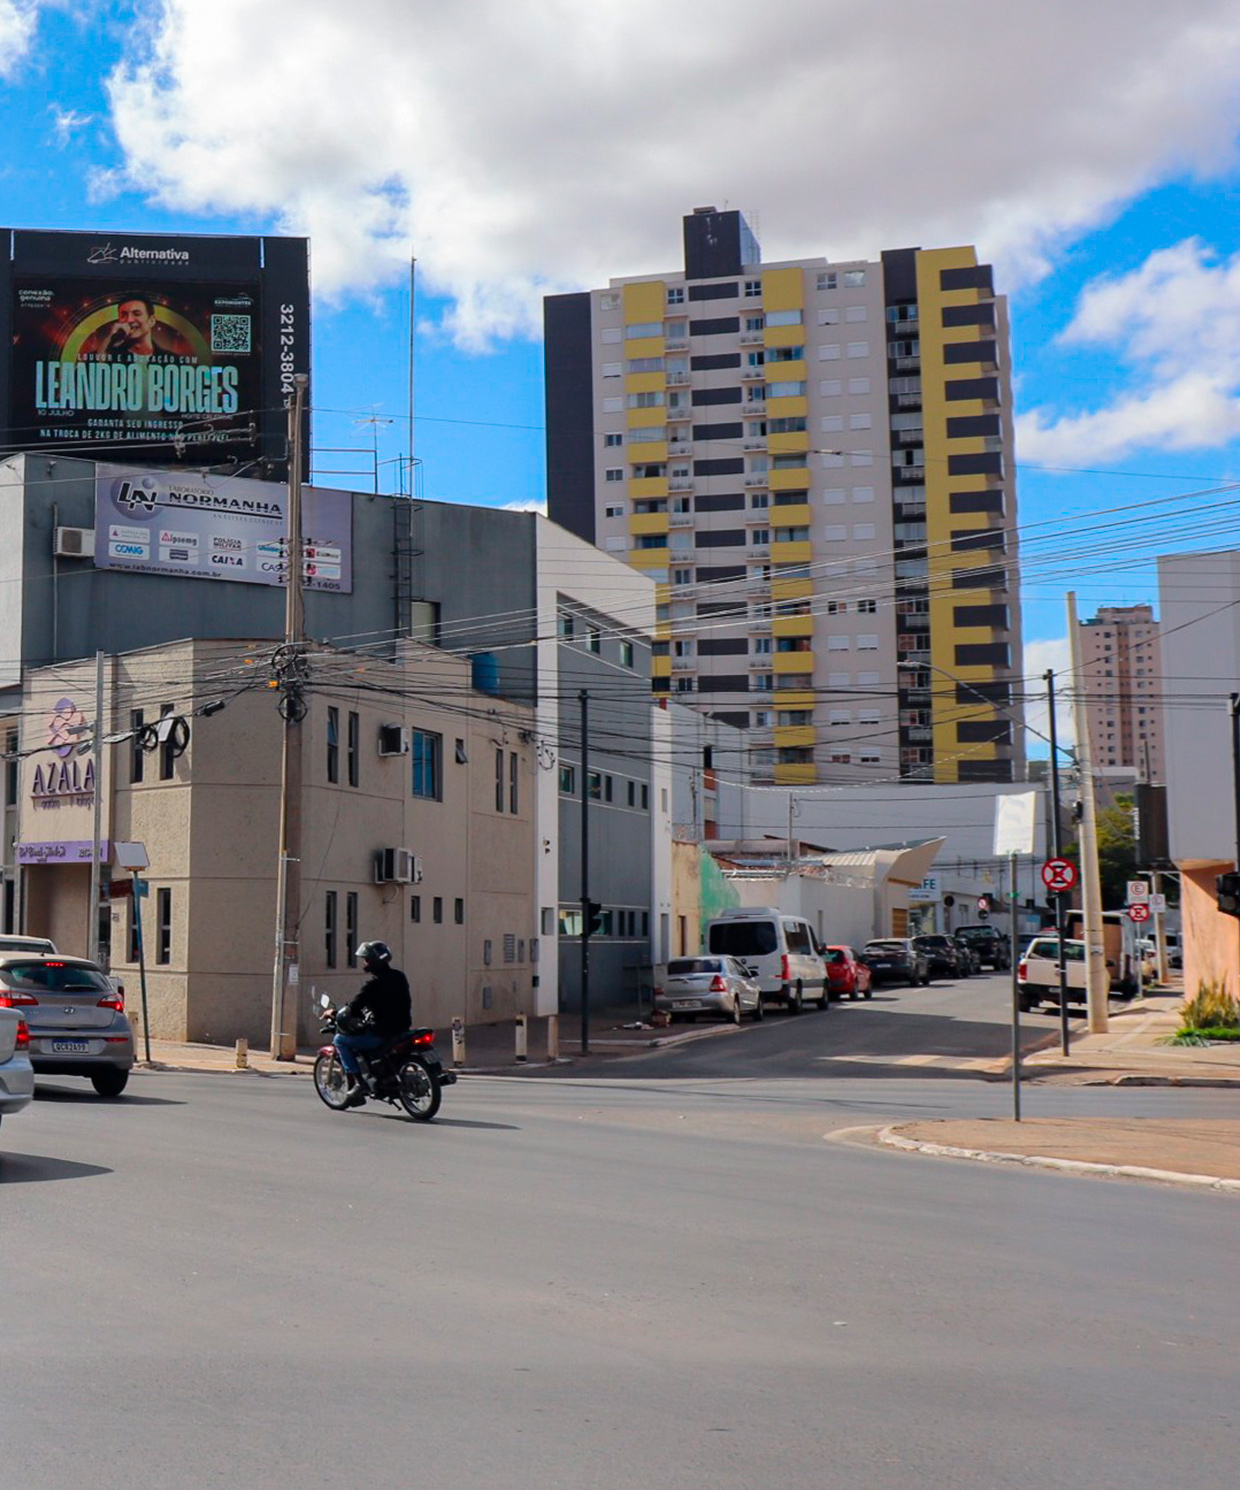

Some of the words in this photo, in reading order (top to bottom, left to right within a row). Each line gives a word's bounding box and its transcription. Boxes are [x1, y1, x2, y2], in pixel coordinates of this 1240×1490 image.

[120, 246, 189, 260] Alternativa
[280, 303, 294, 394] 3212-3804
[77, 353, 112, 361] LOUVOR
[117, 354, 122, 362] E
[179, 356, 198, 364] COM
[35, 360, 143, 411] LEANDRO
[147, 364, 238, 413] BORGES
[87, 418, 124, 427] GARANTA
[126, 420, 143, 428] SEU
[145, 420, 184, 429] INGRESSO
[40, 429, 51, 437] NA
[53, 429, 79, 438] TROCA
[82, 430, 92, 439] DE
[95, 430, 111, 439] 2KG
[113, 431, 123, 440] DE
[126, 431, 167, 440] ALIMENTO
[169, 492, 283, 515] NORMANHA
[211, 555, 243, 566] CAIXA
[32, 758, 95, 793] AZALA
